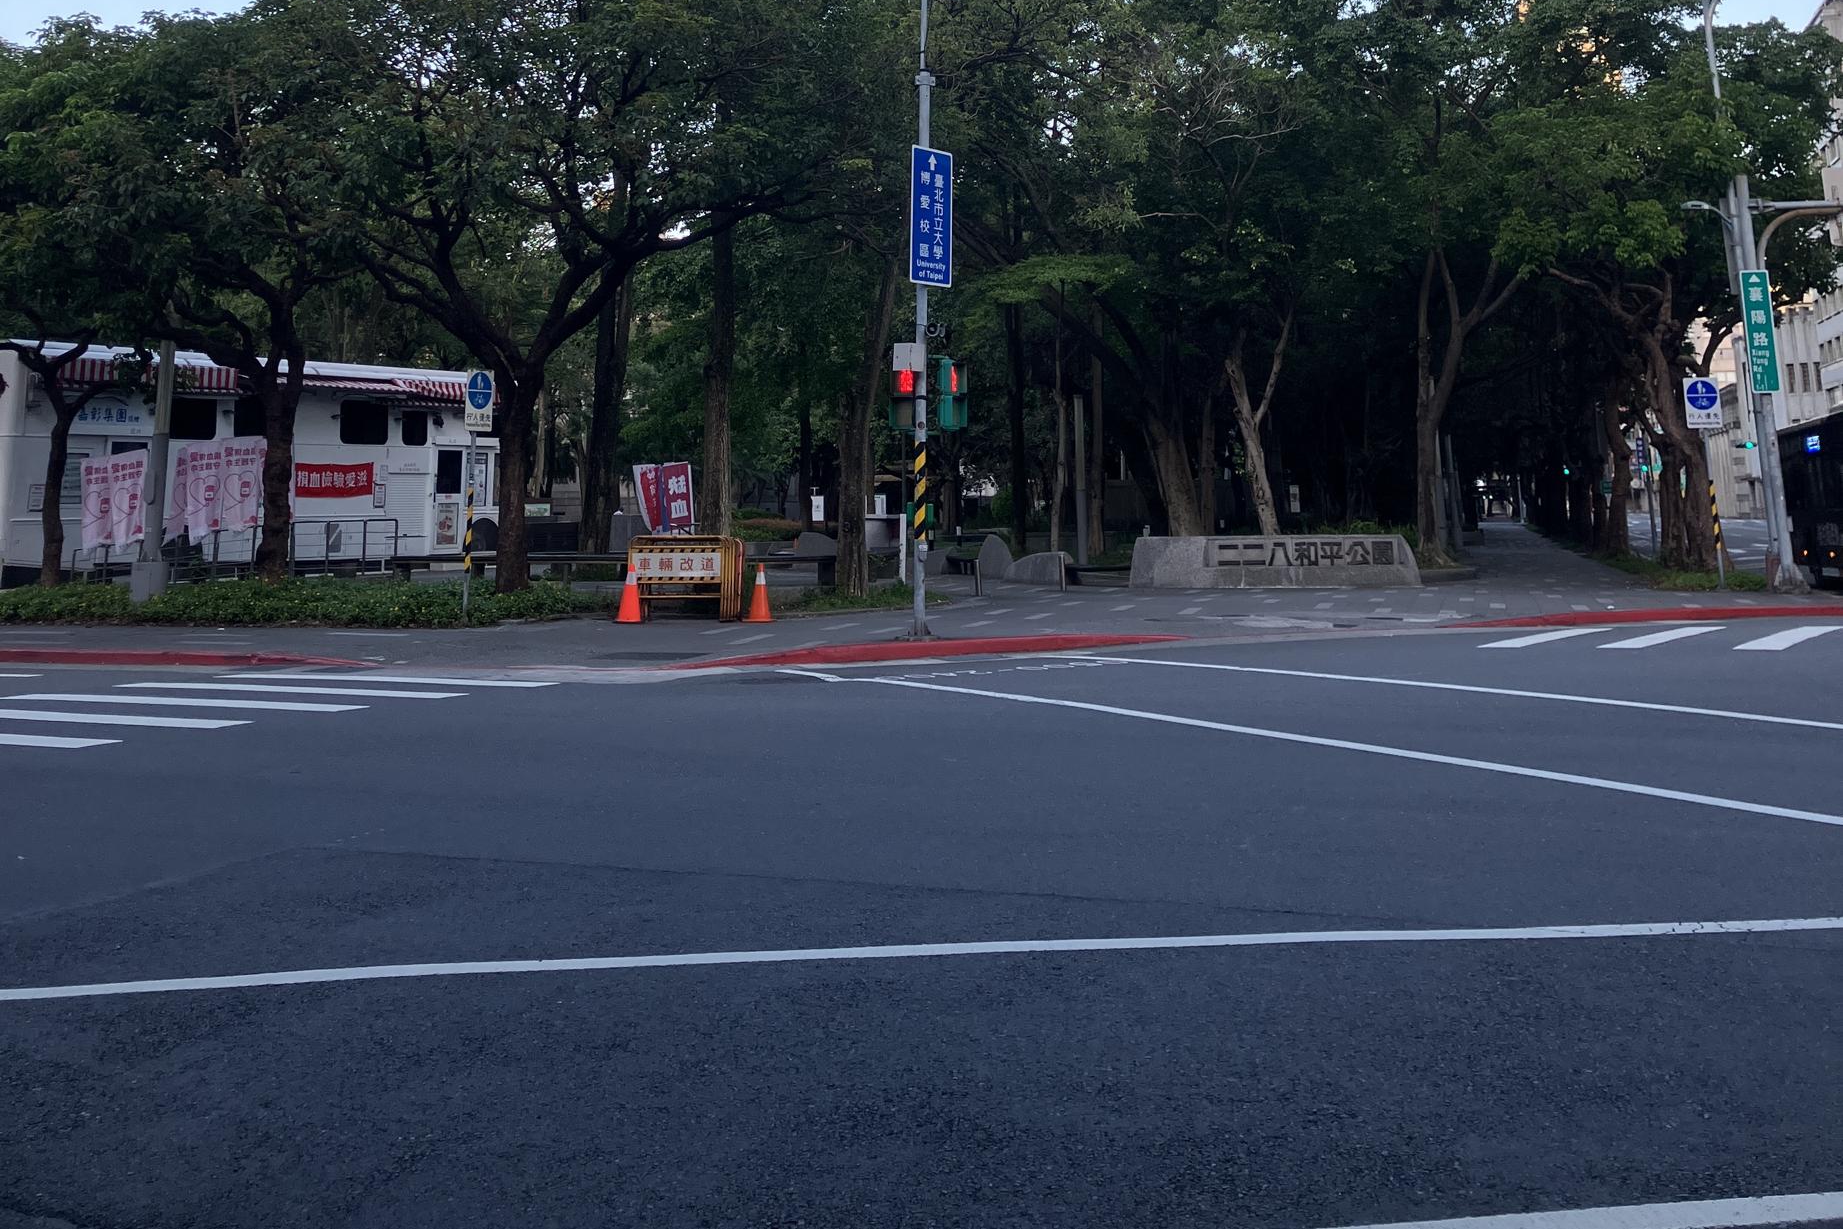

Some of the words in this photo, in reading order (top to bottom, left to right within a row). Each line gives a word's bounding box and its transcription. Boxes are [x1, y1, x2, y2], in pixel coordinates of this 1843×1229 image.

[920, 171, 930, 257] 博愛校區
[934, 174, 944, 259] 臺北市立大學
[917, 259, 946, 271] University
[926, 271, 944, 280] Taipei
[1748, 287, 1769, 347] 襄陽路
[1753, 358, 1768, 366] Yang
[466, 413, 491, 422] 行人優先
[1217, 540, 1395, 567] 二二八和平公園
[639, 557, 714, 571] 車輛改道
